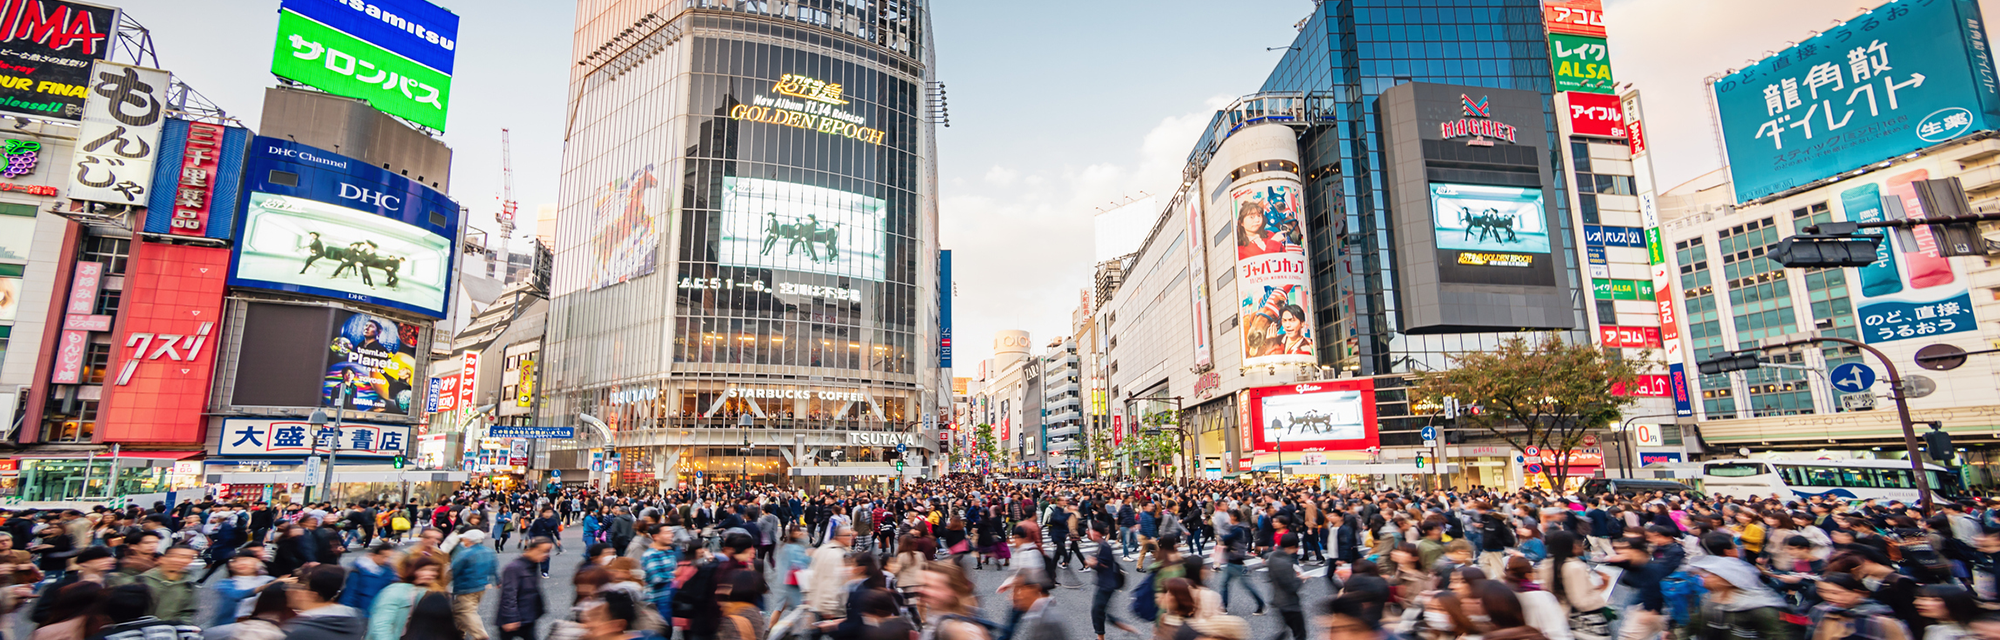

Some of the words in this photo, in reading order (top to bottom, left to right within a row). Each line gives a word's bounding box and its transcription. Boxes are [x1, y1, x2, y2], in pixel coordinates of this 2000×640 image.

[1553, 7, 1605, 26] アコム
[1555, 40, 1606, 61] レイク
[288, 33, 442, 110] サロンパス
[1558, 61, 1612, 80] ALSA
[1763, 39, 1893, 117] 龍角散
[772, 73, 849, 106] 超特急
[753, 94, 774, 106] New
[774, 99, 804, 113] Album
[804, 100, 831, 116] 11.14
[832, 109, 865, 125] Release
[1571, 104, 1621, 121] アイフル
[1755, 72, 1926, 150] ダイレクト
[77, 66, 162, 202] もんじゃ
[730, 103, 817, 129] GOLDEN
[817, 117, 885, 146] EPOCH
[1441, 118, 1517, 144] MAGNET
[1611, 127, 1625, 137] 8F
[1920, 112, 1969, 138] 生薬
[268, 145, 297, 158] DHC
[299, 152, 347, 169] Channel
[171, 124, 216, 230] 三千里薬品
[338, 181, 400, 211] DHC
[1586, 230, 1640, 244] レオパレス21
[1243, 258, 1304, 278] ジャパンカップ
[73, 265, 97, 311] お好み焼
[1612, 284, 1632, 292] ALSA
[1660, 300, 1674, 324] アコム
[1865, 301, 1970, 327] のど、直接、
[1605, 331, 1644, 343] アコム
[1878, 318, 1956, 340] うるおう
[357, 347, 388, 358] teamLab
[941, 327, 950, 360] SEIBU
[60, 332, 82, 381] もんじゃ焼
[348, 351, 399, 370] Planets
[363, 366, 386, 374] TOKYO
[462, 357, 476, 396] カラオケ
[729, 387, 811, 400] STARBUCKS
[818, 390, 864, 401] COFFEE
[1295, 384, 1321, 394] Glico
[1673, 371, 1687, 402] PROMISE
[232, 426, 402, 451] 大盛堂書店
[850, 432, 915, 447] TSUTAYA
